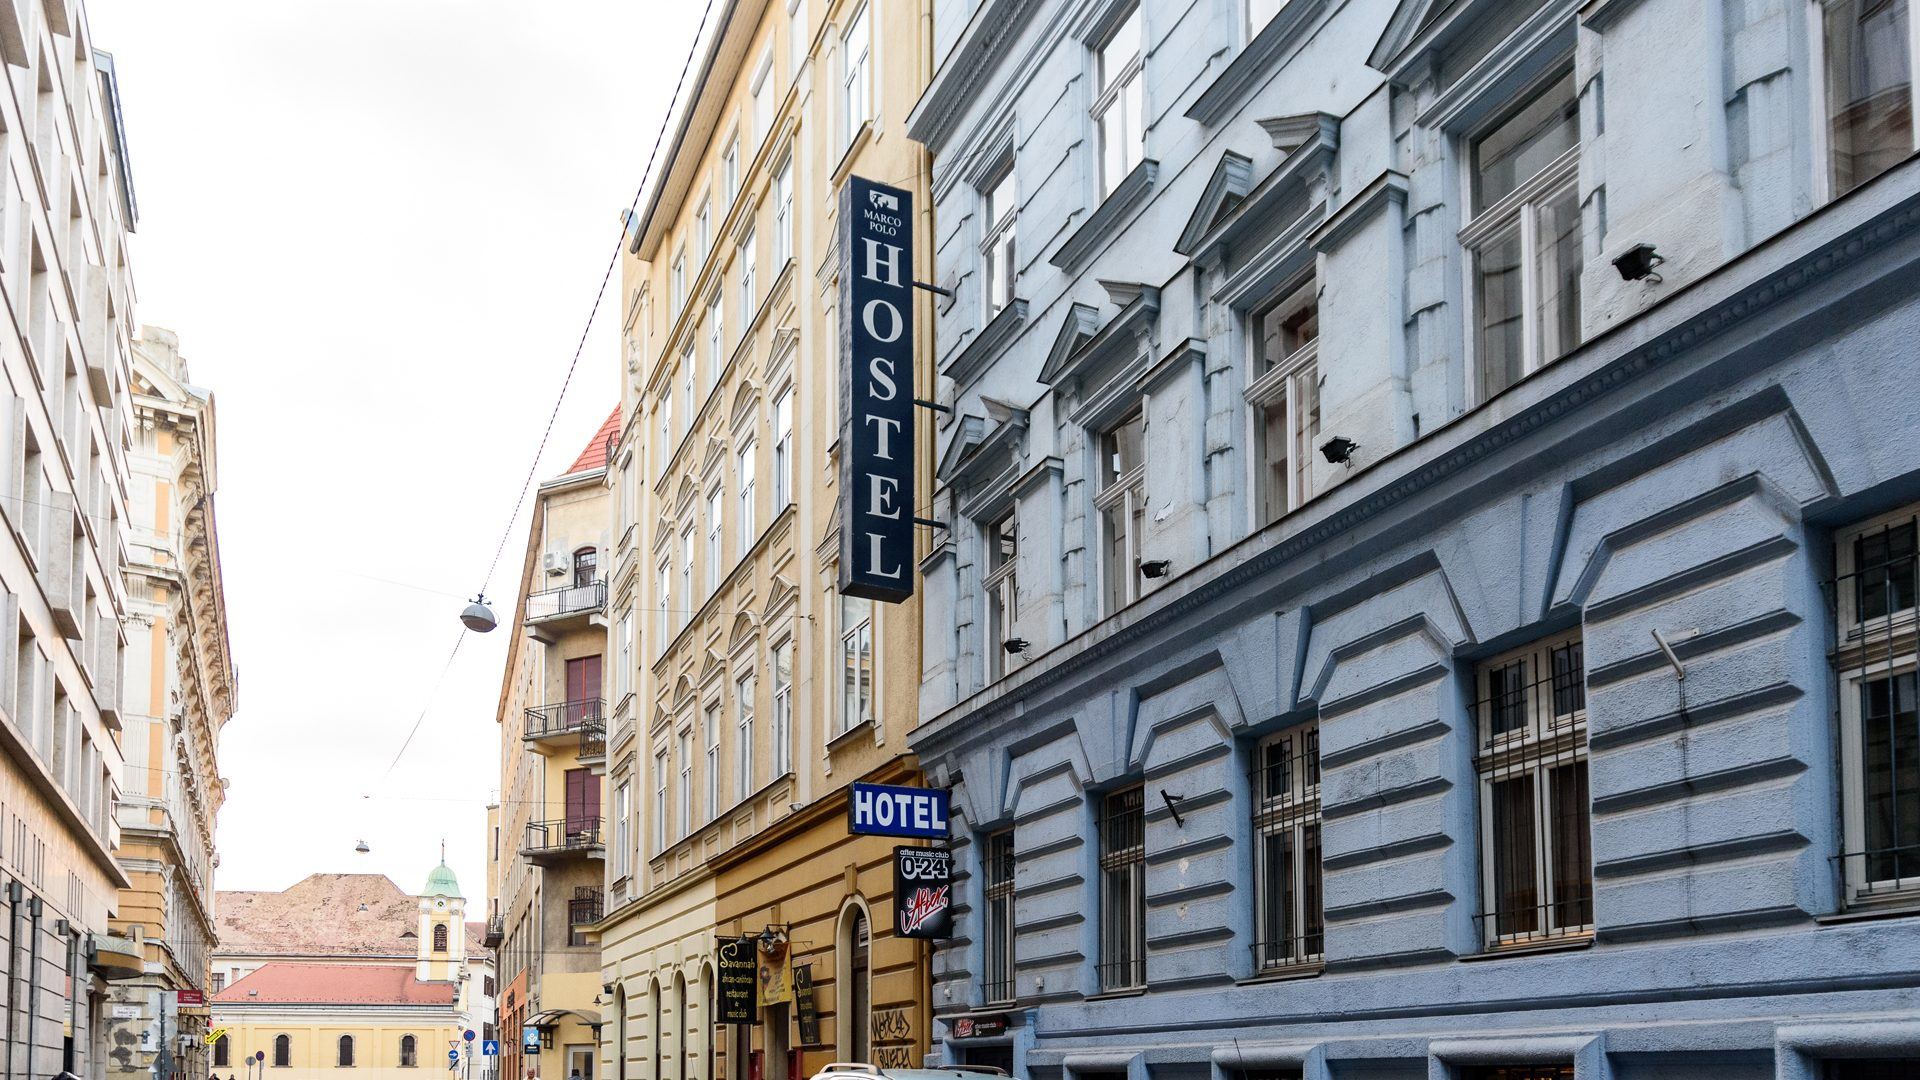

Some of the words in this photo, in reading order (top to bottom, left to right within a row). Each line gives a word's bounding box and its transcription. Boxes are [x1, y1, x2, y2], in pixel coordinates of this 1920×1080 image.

[863, 208, 902, 228] MARCO
[869, 221, 897, 237] POLO
[860, 236, 904, 580] HOSTEL
[855, 790, 946, 830] HOTEL
[915, 850, 935, 858] music
[900, 857, 949, 880] 0-24
[720, 943, 755, 968] Savannah
[726, 989, 748, 999] restaurant
